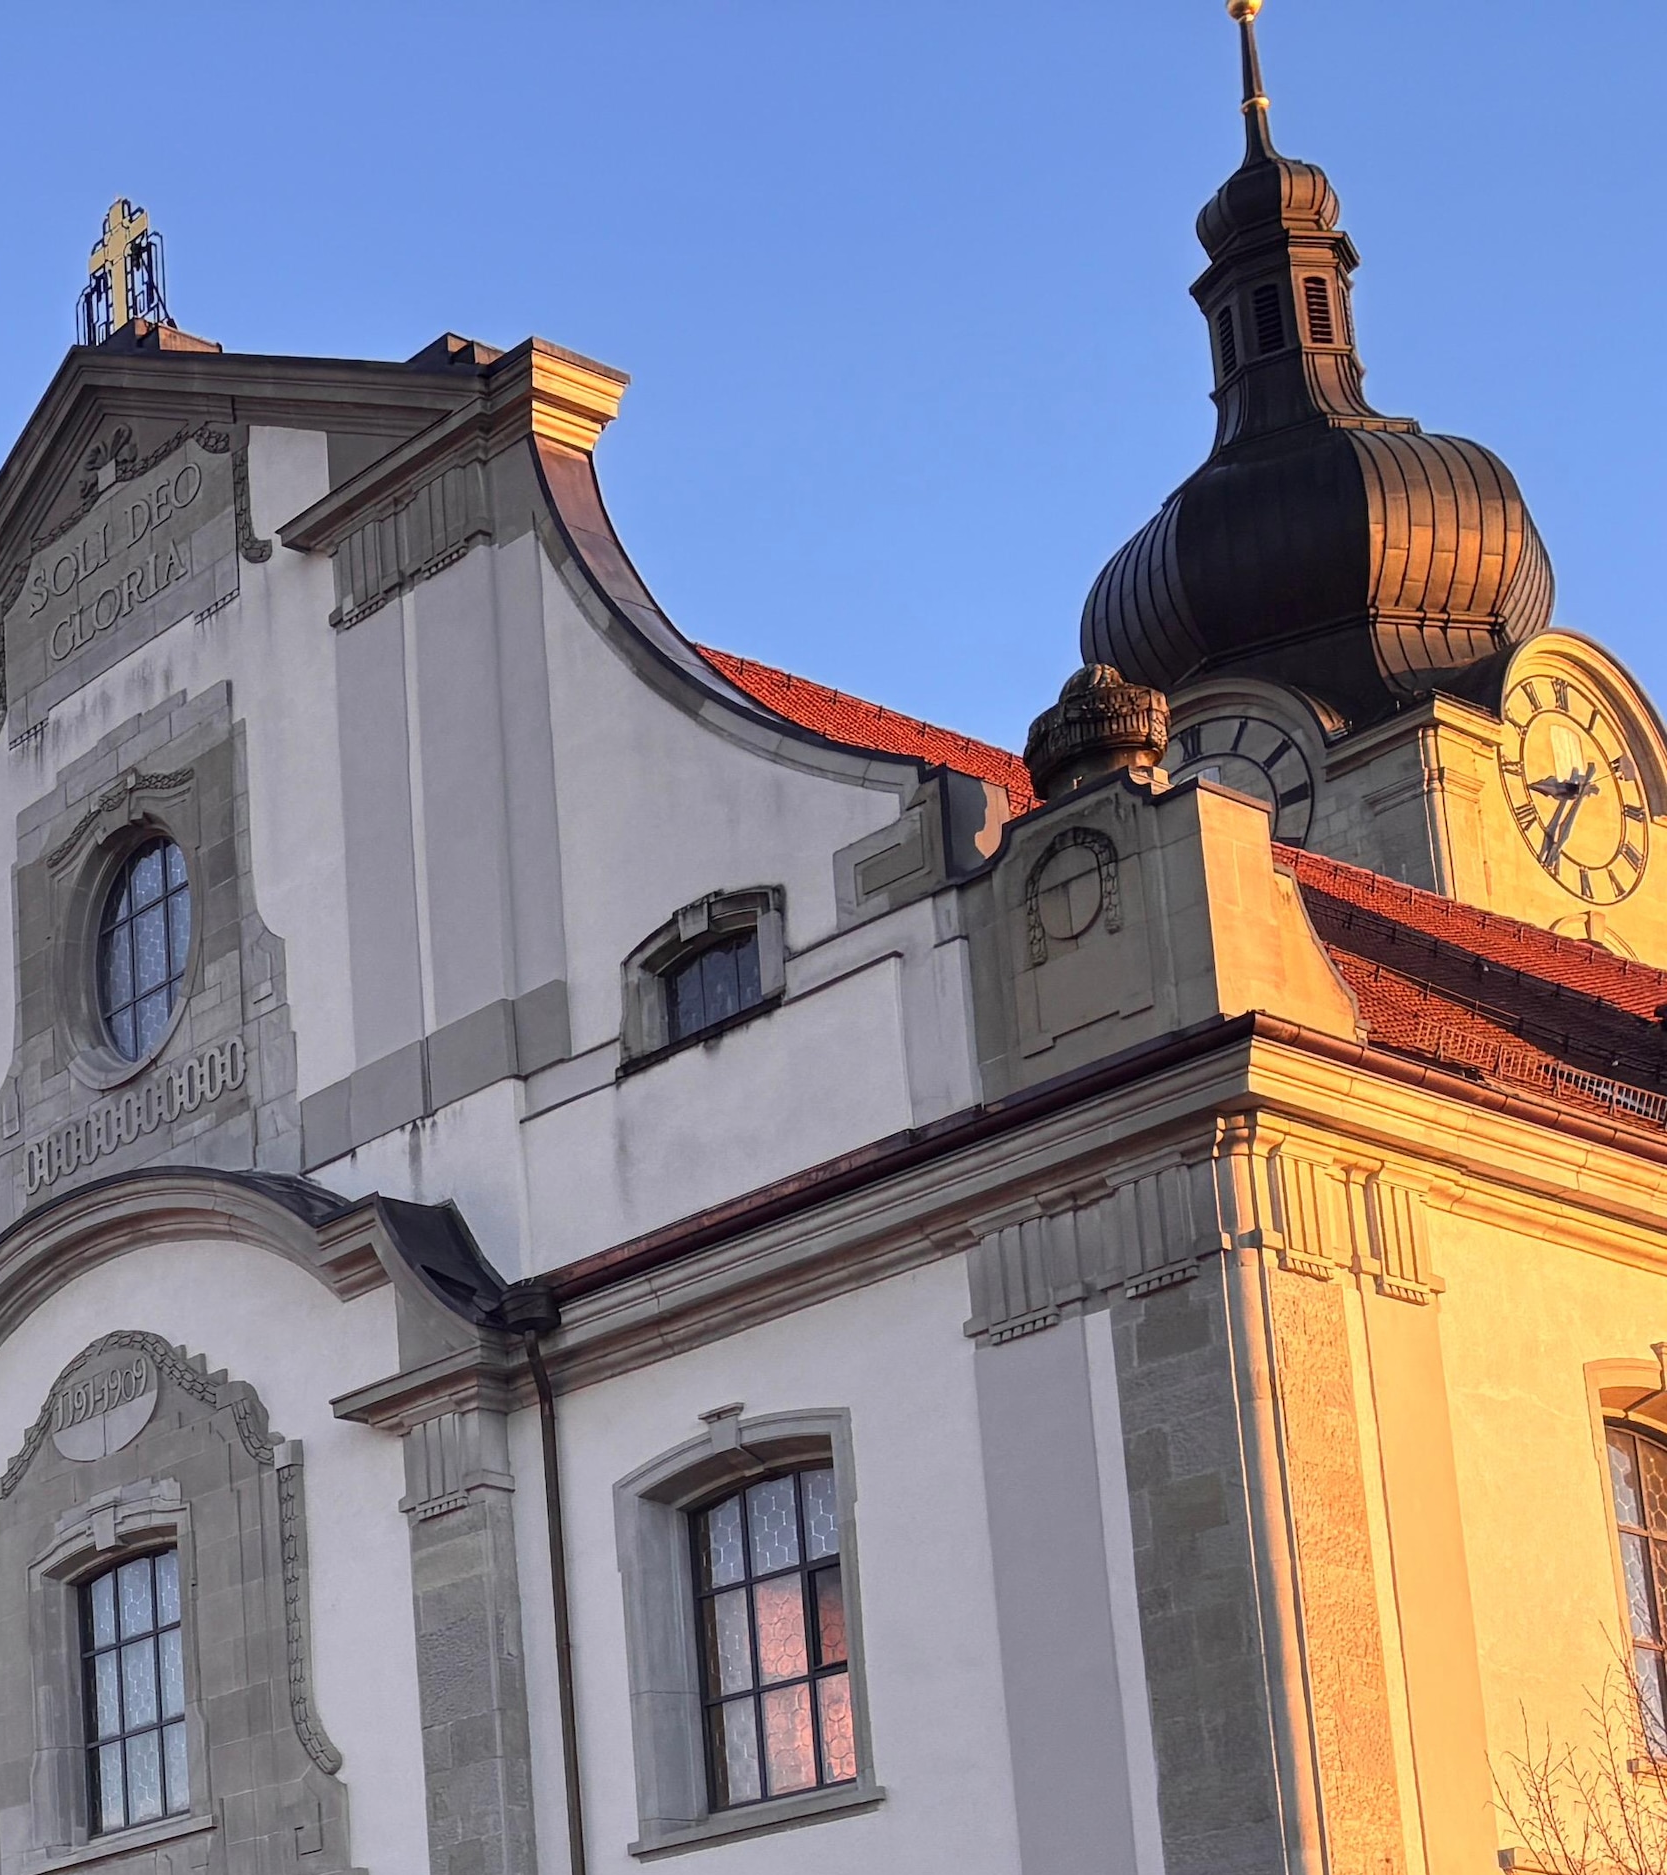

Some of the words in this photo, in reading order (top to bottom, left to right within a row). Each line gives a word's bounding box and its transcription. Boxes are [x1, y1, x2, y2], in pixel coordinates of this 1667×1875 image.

[28, 521, 110, 620] SOLI
[124, 462, 203, 549] DEO
[50, 538, 189, 661] GLORIA
[1178, 723, 1203, 762] XII
